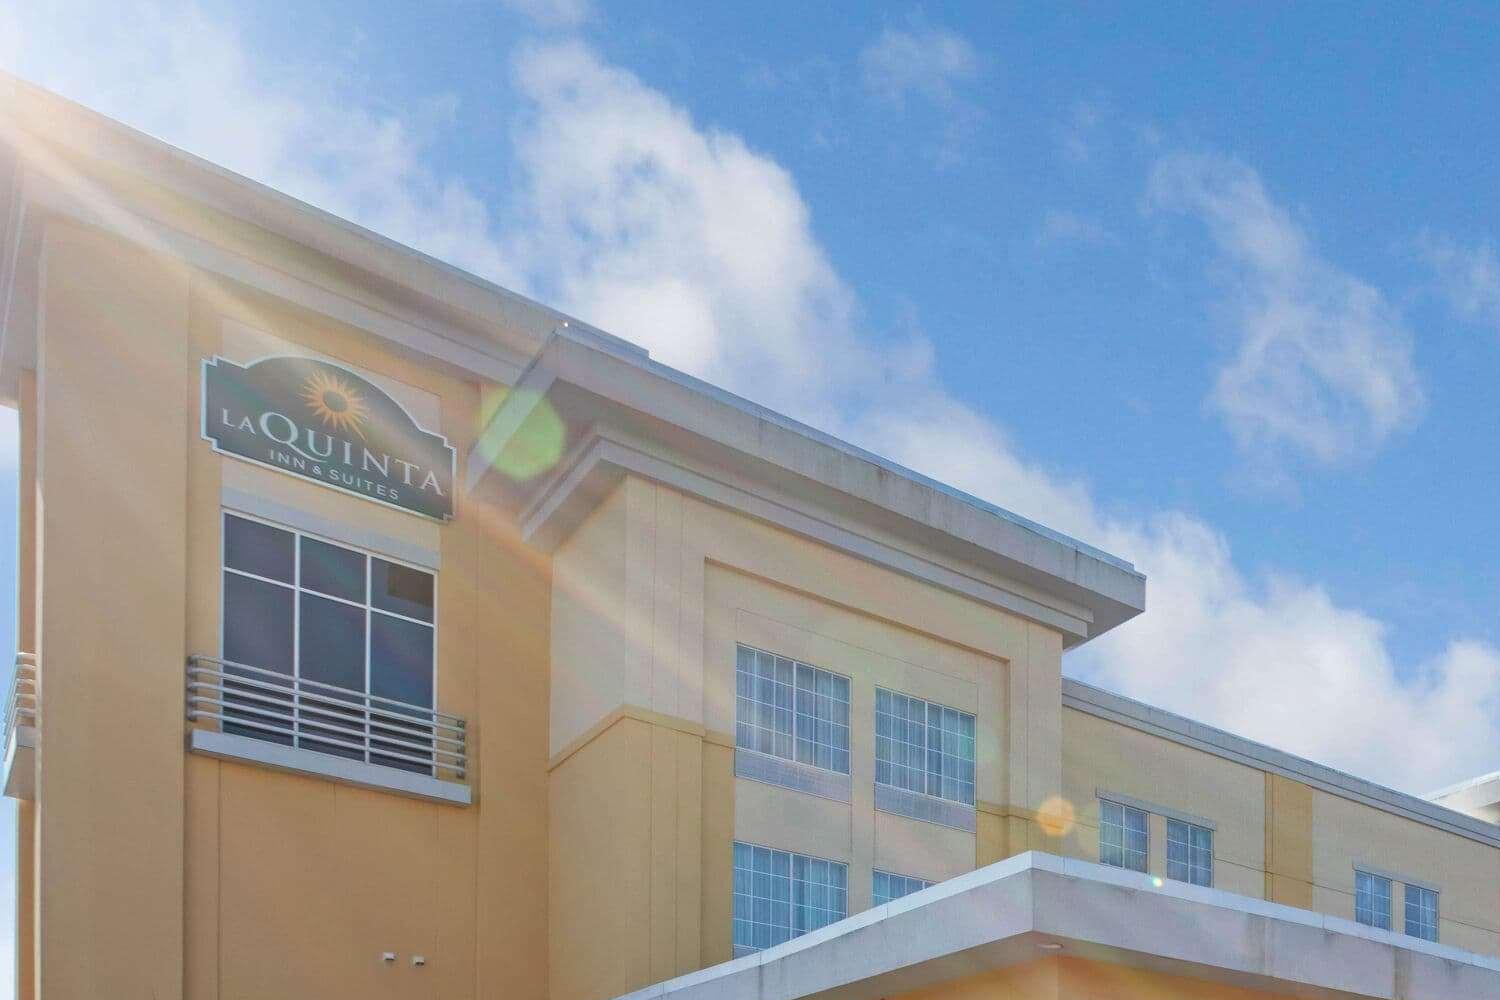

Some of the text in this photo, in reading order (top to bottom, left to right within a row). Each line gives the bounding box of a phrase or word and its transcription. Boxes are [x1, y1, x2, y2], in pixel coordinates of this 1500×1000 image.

[222, 408, 443, 496] LA QUINTA
[270, 449, 399, 500] INN & SUITES
